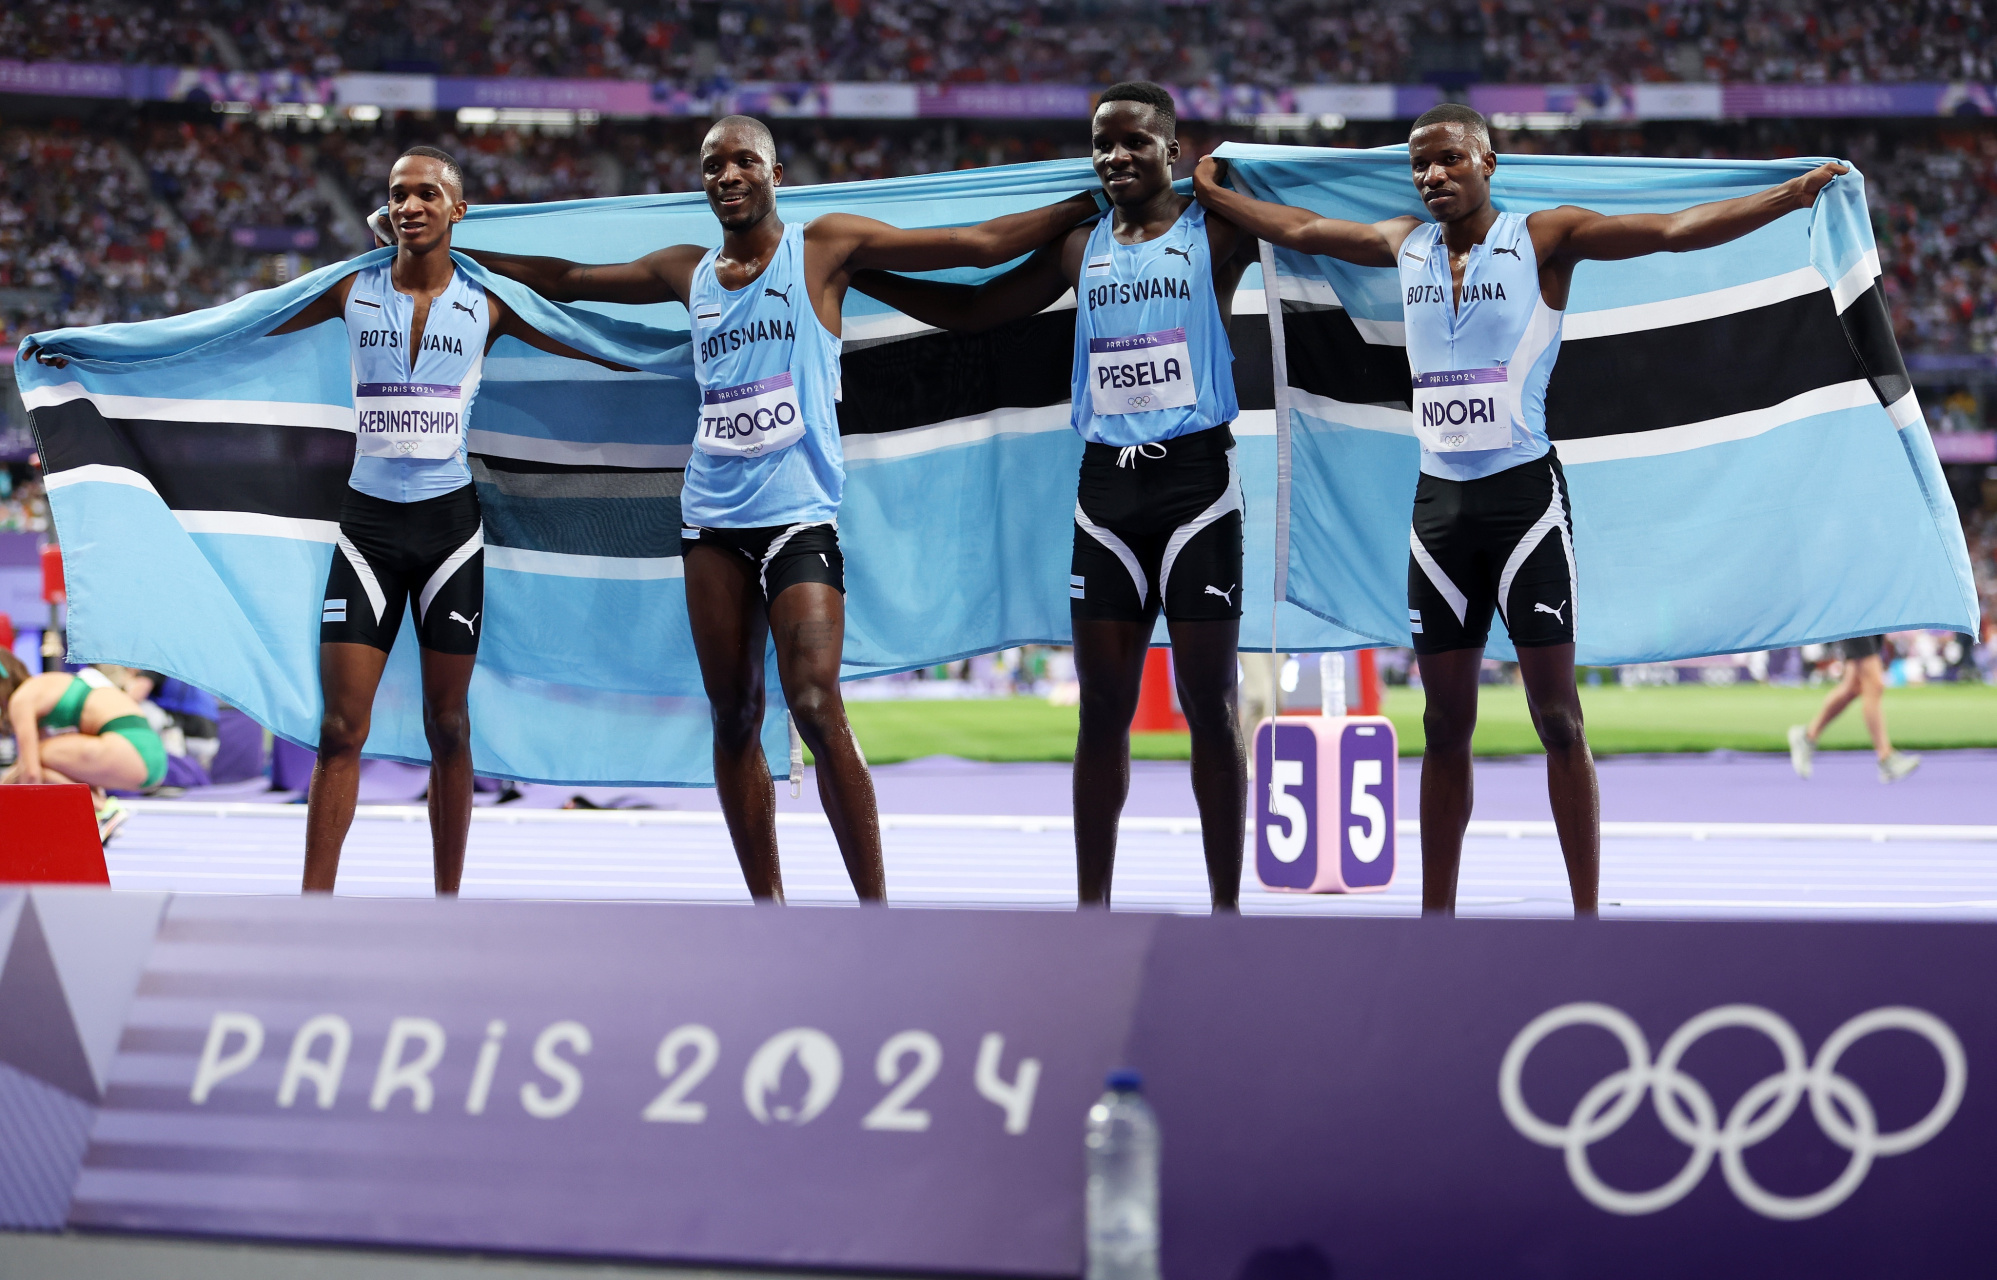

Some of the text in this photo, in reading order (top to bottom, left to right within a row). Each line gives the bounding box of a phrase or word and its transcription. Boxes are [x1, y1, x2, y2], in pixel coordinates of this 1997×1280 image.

[1089, 277, 1190, 311] BOTSWANA
[701, 319, 796, 364] BOTSWANA
[1132, 336, 1158, 346] 2024
[740, 383, 765, 395] 2024
[1098, 358, 1181, 389] PESELA
[1451, 373, 1476, 382] 2024
[410, 386, 435, 394] 2024
[359, 411, 459, 434] KEBINATSHIPI
[704, 402, 795, 439] TEBOGO
[1422, 397, 1495, 427] NDORI
[1266, 760, 1308, 863] 5
[1348, 760, 1387, 863] 5
[640, 1023, 1042, 1135] 2024
